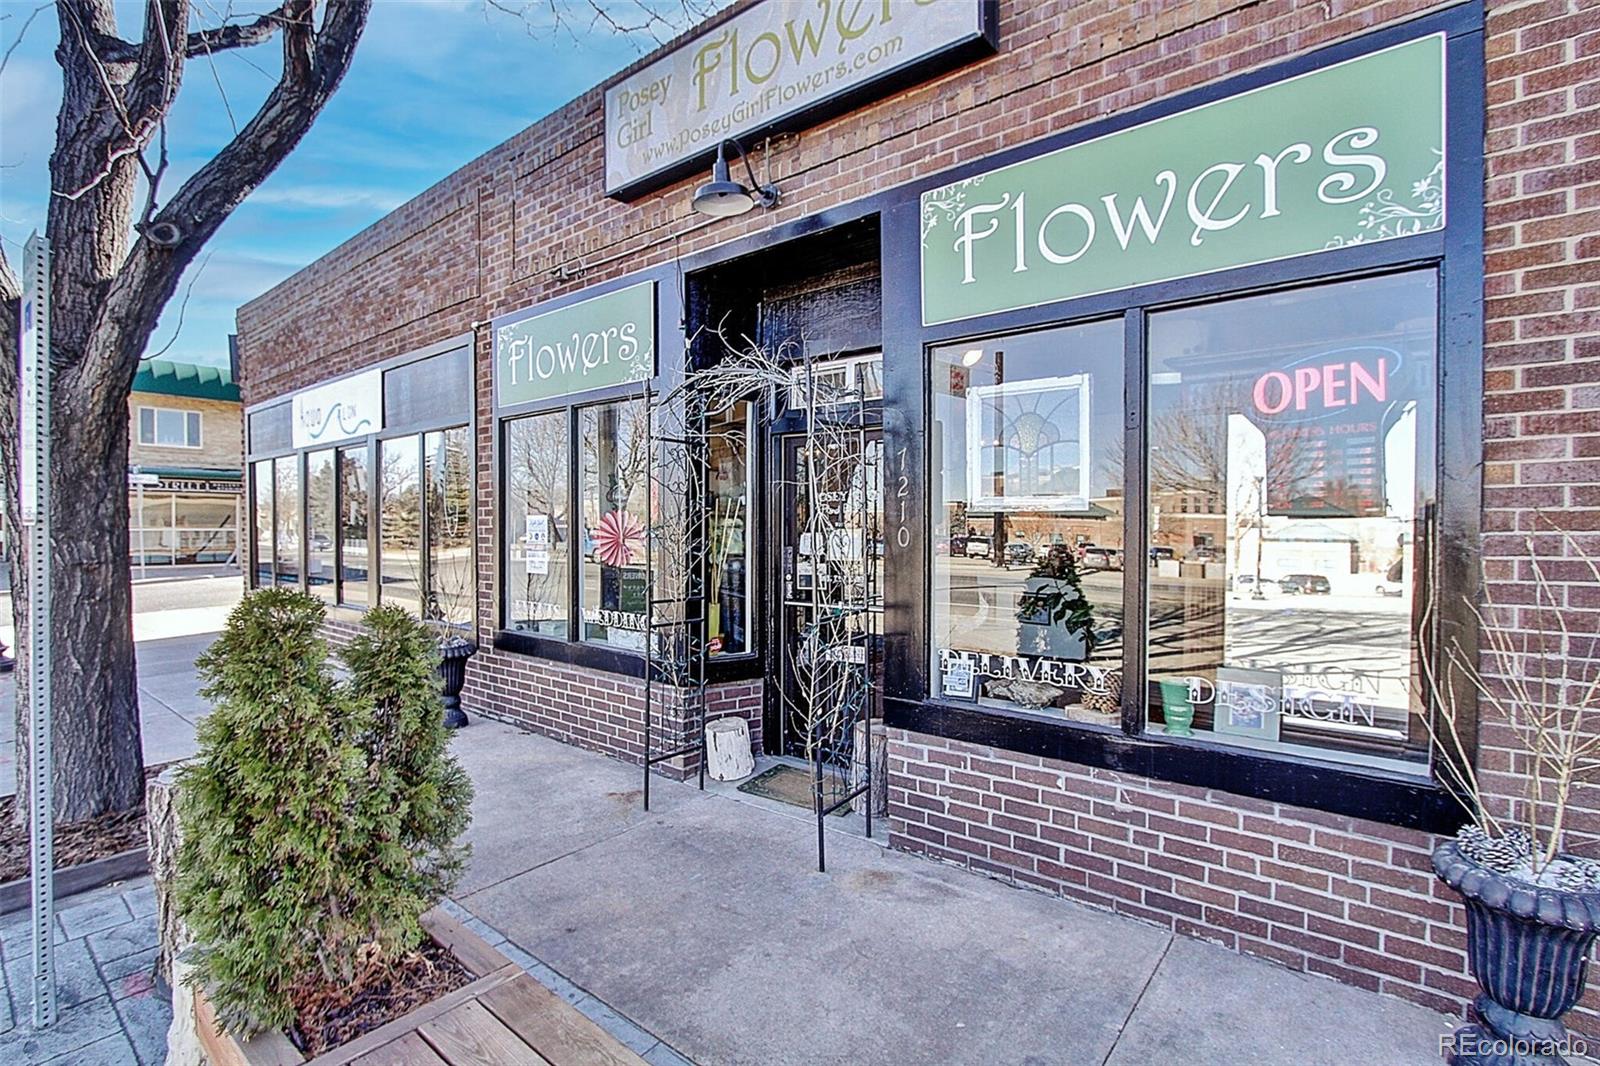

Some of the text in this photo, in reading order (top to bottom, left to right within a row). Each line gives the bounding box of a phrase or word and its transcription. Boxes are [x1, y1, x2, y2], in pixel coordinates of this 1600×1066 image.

[693, 0, 941, 113] Flowe
[616, 72, 674, 120] Posey
[616, 111, 654, 150] Girl
[953, 126, 1389, 284] Flowers
[508, 322, 640, 386] Flowers
[1253, 357, 1386, 415] OPEN
[897, 446, 910, 548] 1210
[938, 649, 1119, 696] DELIVERY
[1184, 676, 1379, 727] DESIGN
